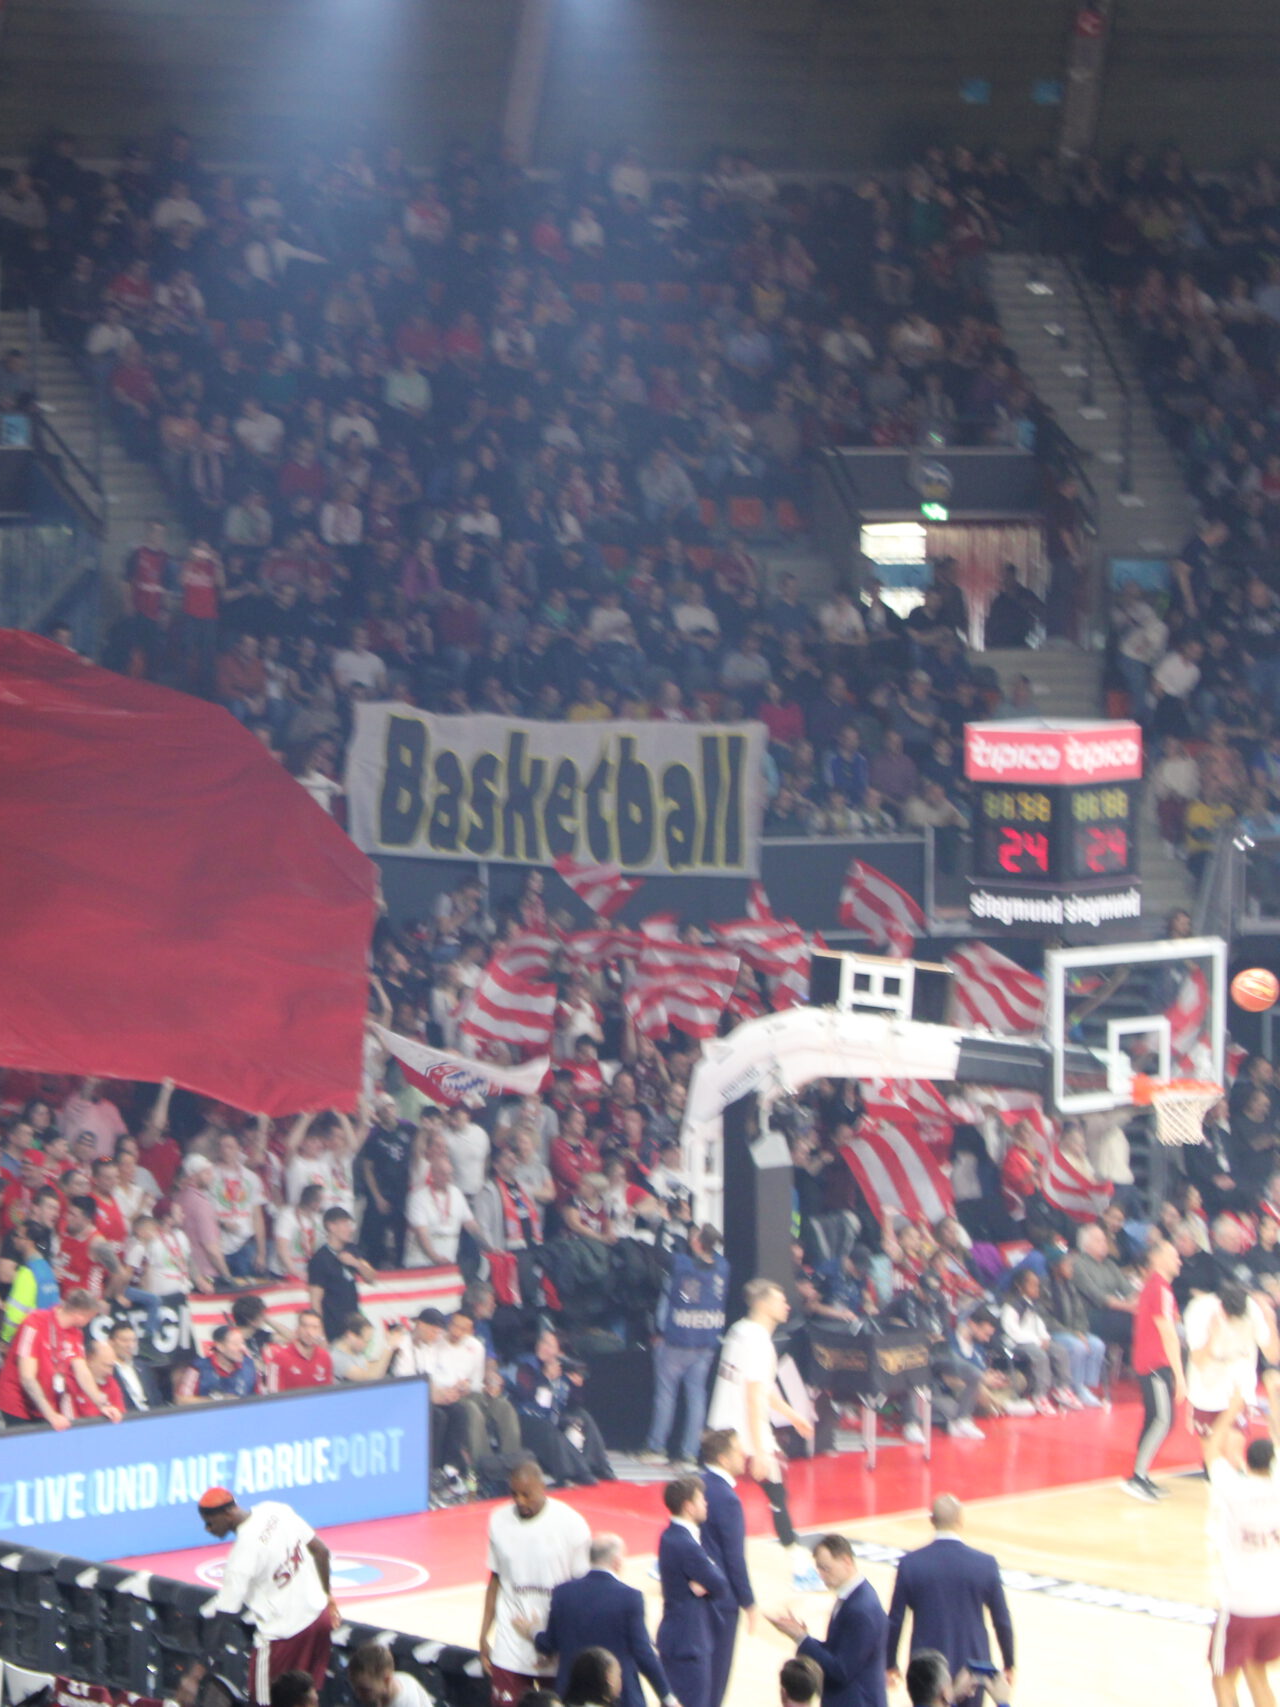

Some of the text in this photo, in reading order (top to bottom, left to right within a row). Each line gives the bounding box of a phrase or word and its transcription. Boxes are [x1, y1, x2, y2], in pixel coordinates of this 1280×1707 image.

[968, 733, 1061, 775] tipico
[1064, 735, 1139, 775] tipico
[376, 713, 748, 873] Basketball
[998, 826, 1049, 874] 24
[1085, 826, 1128, 873] 24
[16, 1471, 87, 1528] LIVE
[93, 1462, 159, 1516] UND
[167, 1452, 230, 1506] AUF
[234, 1436, 333, 1496] ABRUF
